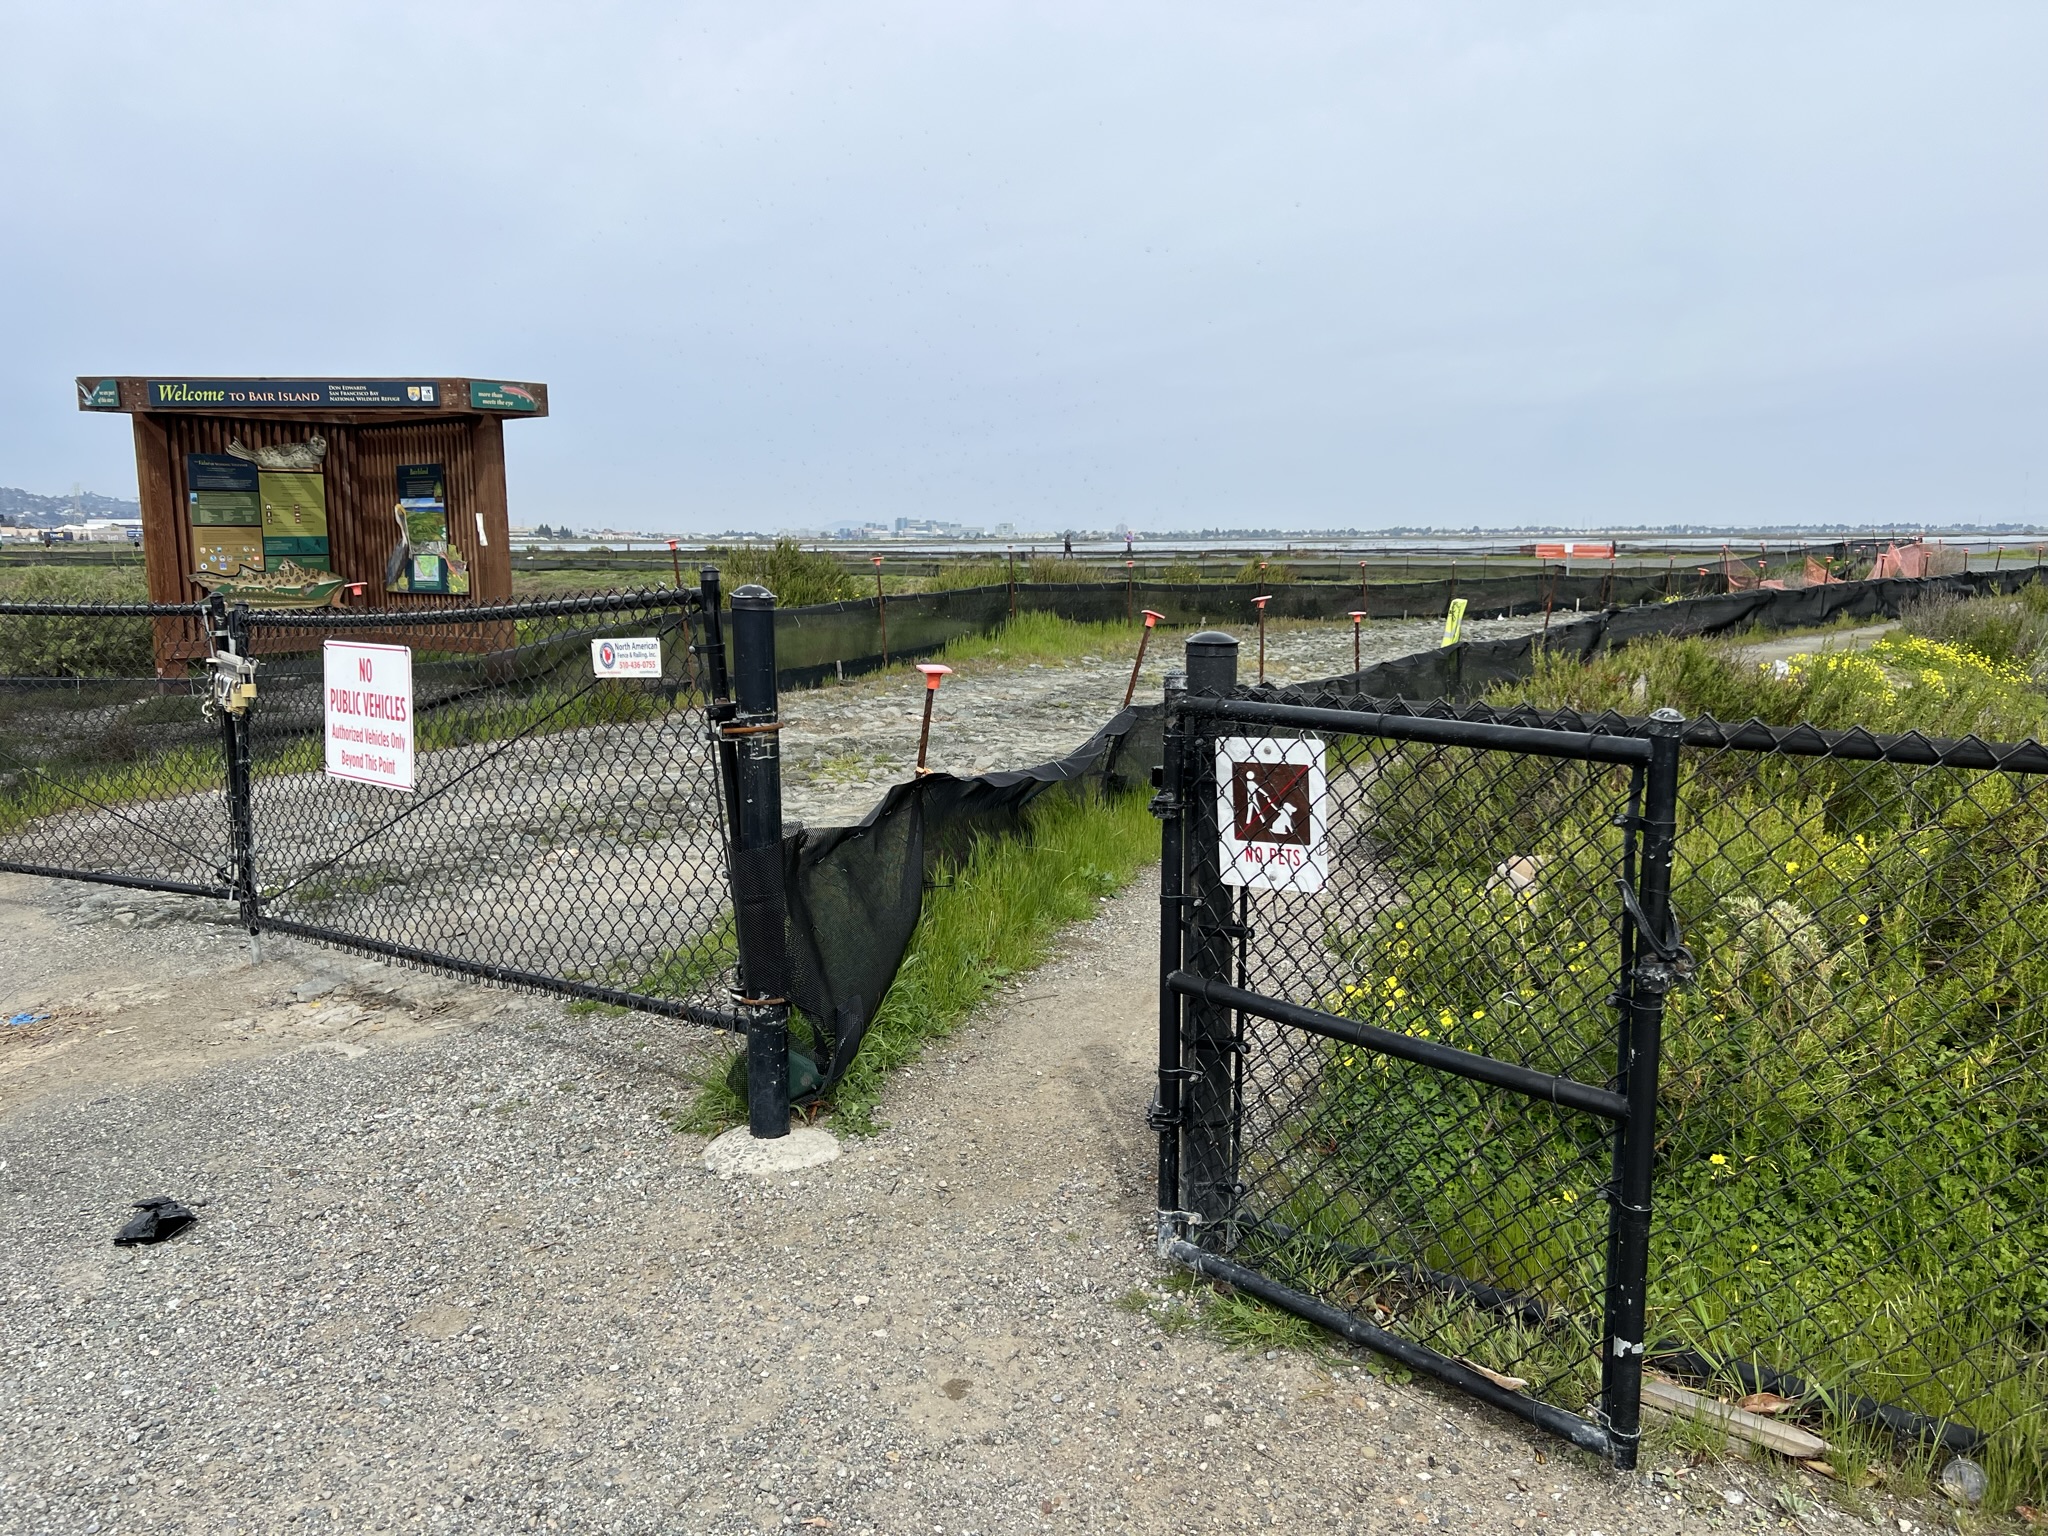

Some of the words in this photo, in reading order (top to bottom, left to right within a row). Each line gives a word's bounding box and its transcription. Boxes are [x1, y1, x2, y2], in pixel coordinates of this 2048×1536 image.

[158, 384, 224, 402] Welcome
[228, 392, 245, 402] TO
[249, 391, 275, 402] BAIR
[278, 391, 320, 402] ISLAND
[614, 642, 631, 651] North
[632, 641, 658, 651] American
[358, 657, 373, 683] NO
[619, 660, 656, 670] 510-436-0755
[330, 688, 361, 716] PUBLIC
[363, 693, 407, 722] VEHICLES
[331, 723, 364, 743] Authorized
[364, 729, 390, 748] Vehicles
[391, 732, 406, 752] Only
[341, 750, 364, 770] Beyond
[365, 754, 377, 772] This
[379, 757, 396, 775] Point
[1245, 846, 1263, 864] NO
[1269, 847, 1301, 867] PETS
